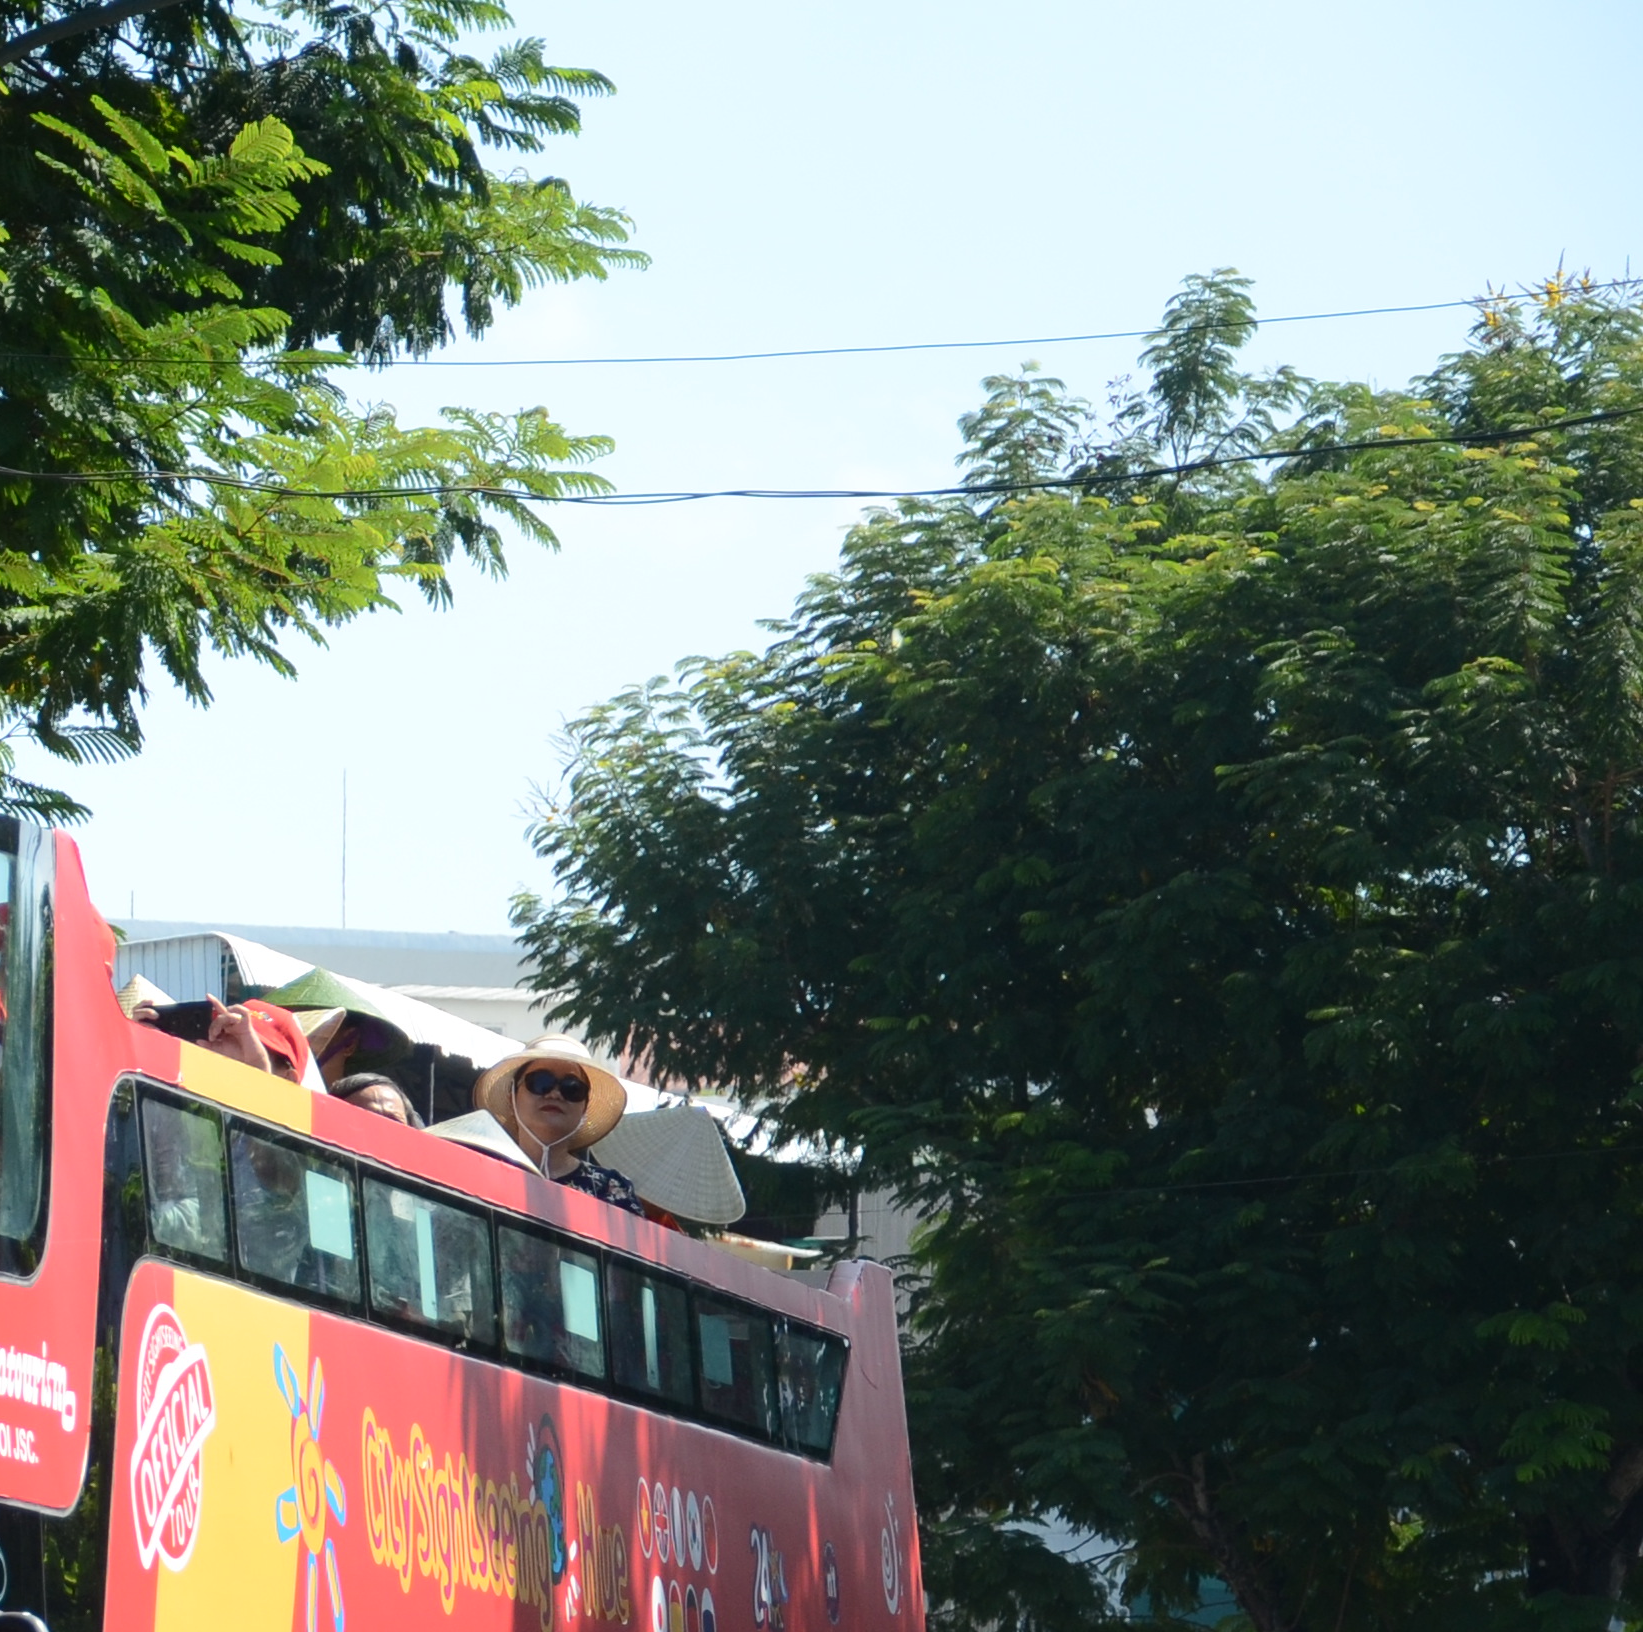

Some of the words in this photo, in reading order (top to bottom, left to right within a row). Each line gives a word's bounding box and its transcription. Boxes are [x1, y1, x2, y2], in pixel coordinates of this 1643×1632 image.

[13, 1426, 40, 1464] JSC.
[140, 1363, 210, 1528] OFFICIAL
[168, 1463, 200, 1548] TOUR
[576, 1478, 631, 1626] Hue
